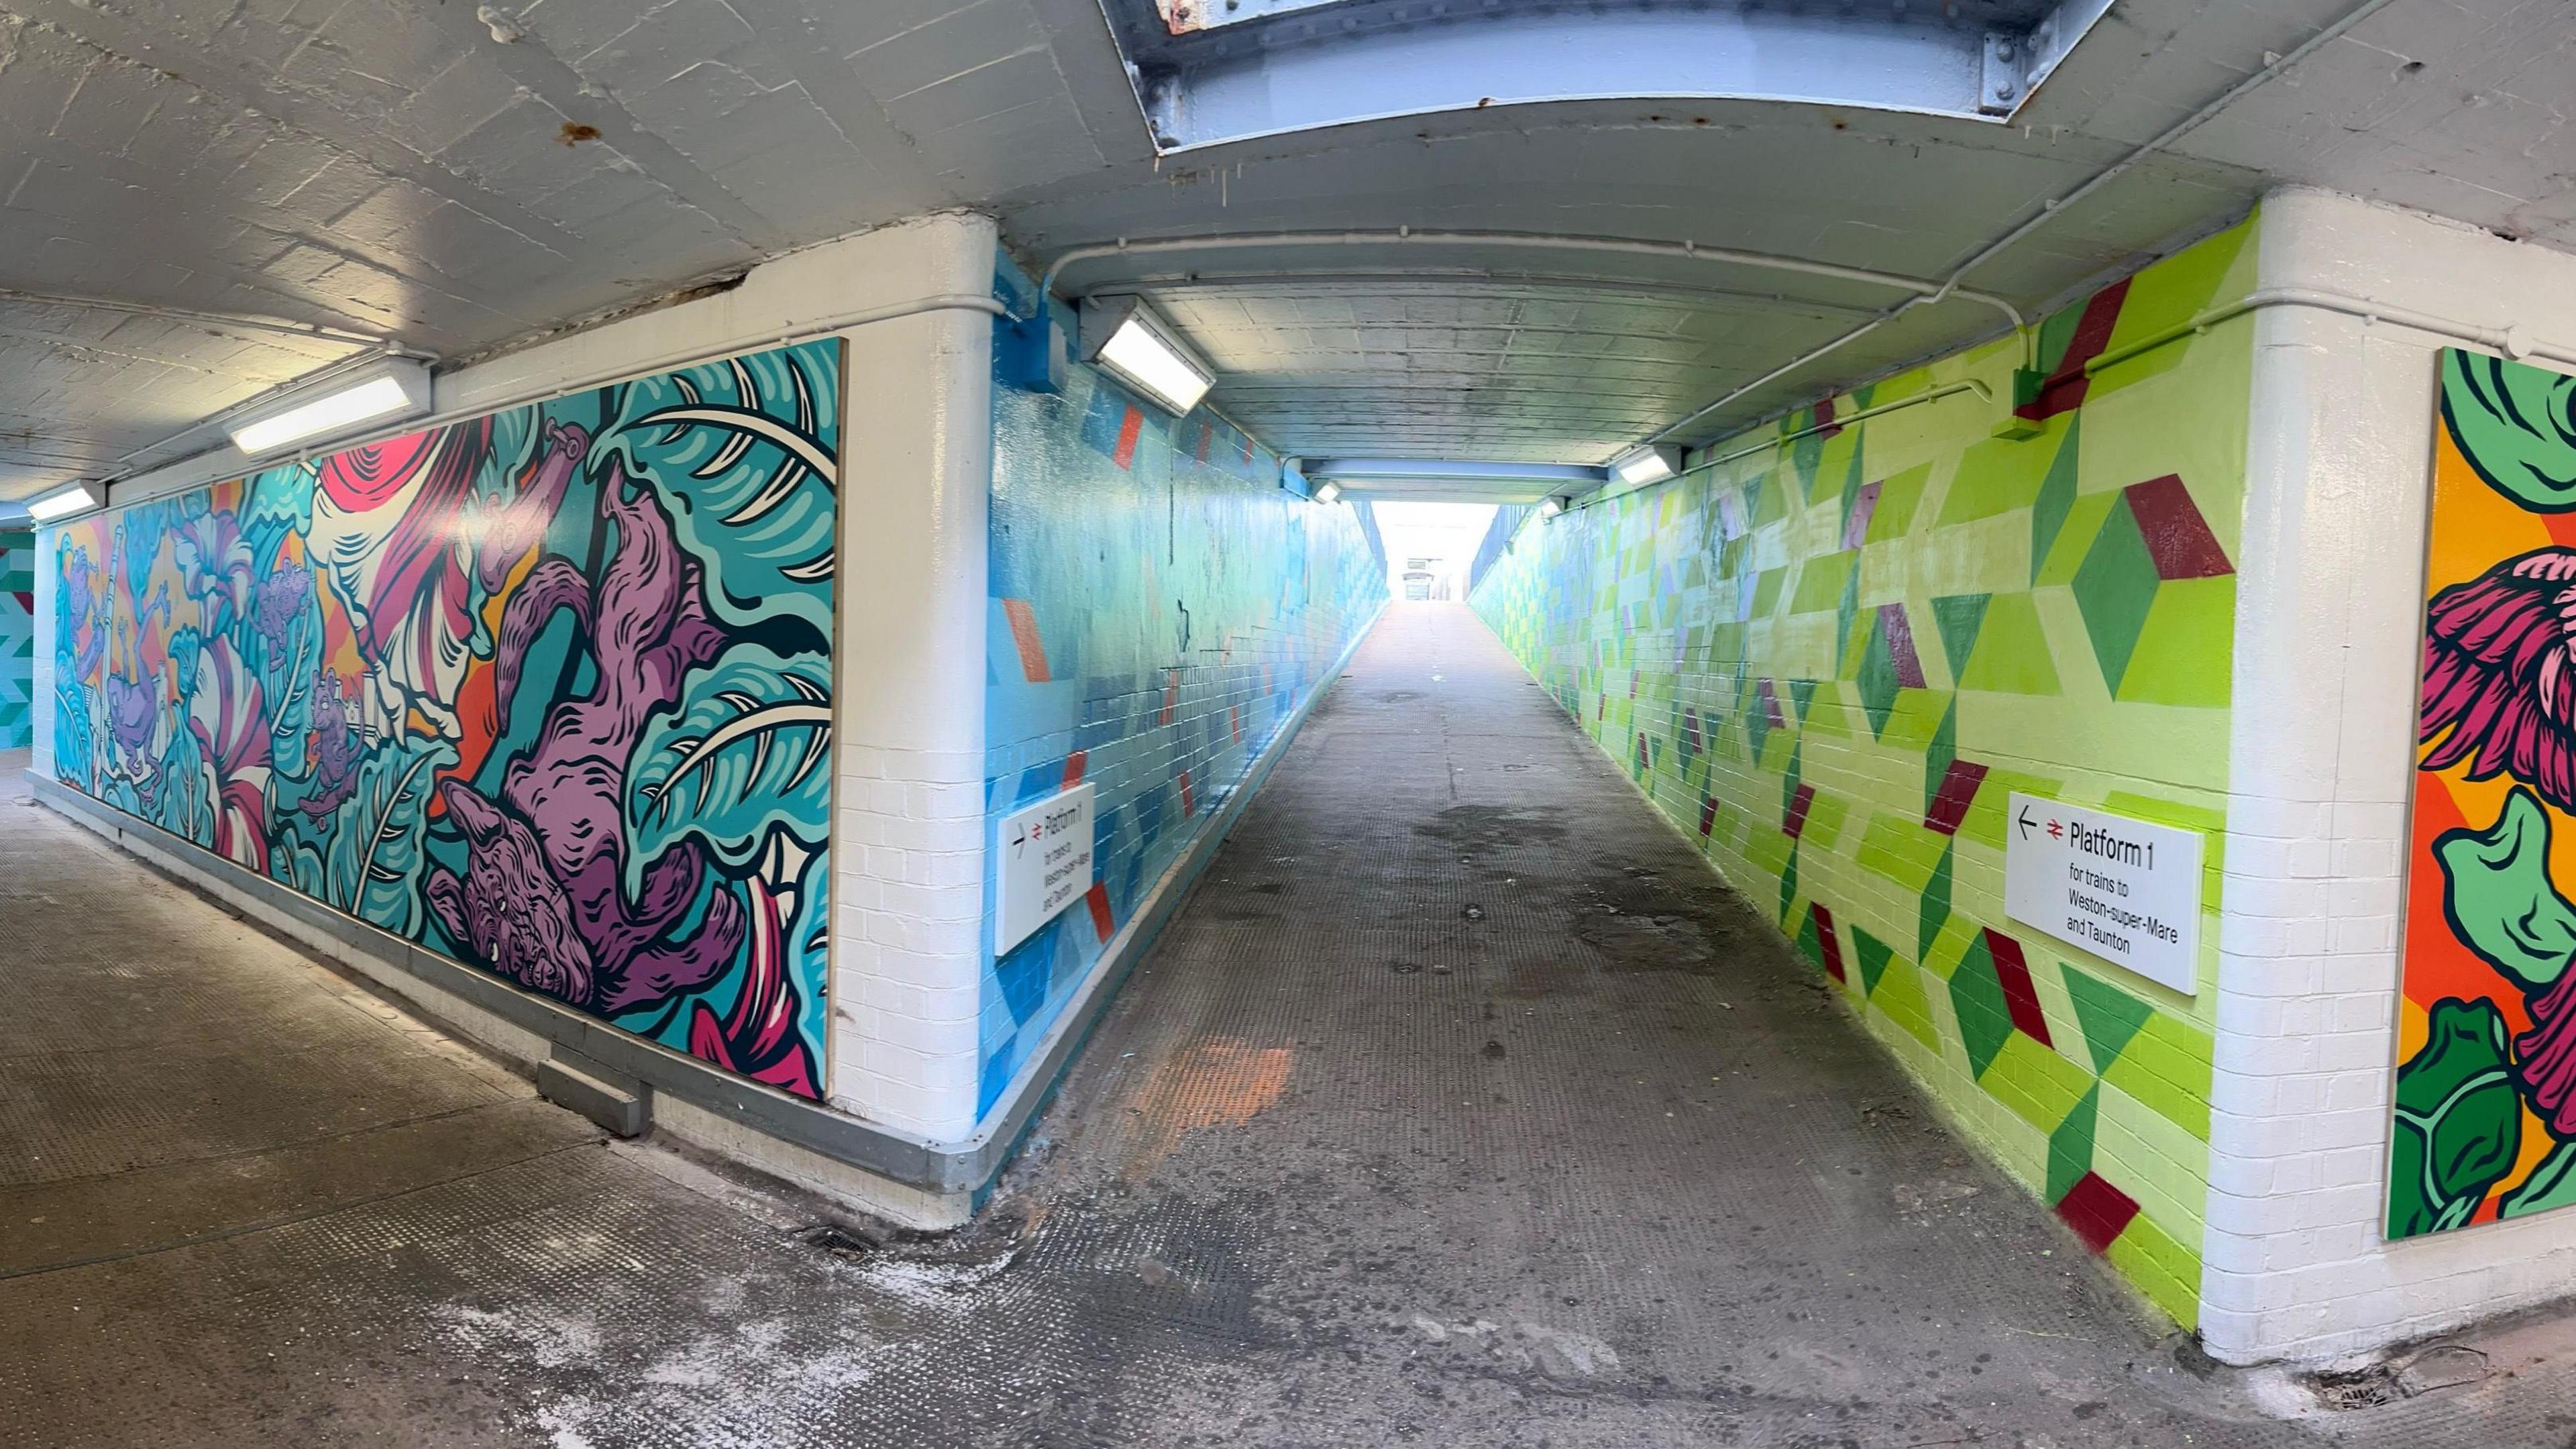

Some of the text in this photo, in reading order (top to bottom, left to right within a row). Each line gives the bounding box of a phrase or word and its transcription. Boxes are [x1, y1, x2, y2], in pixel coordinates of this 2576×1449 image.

[2070, 821, 2153, 871] Platform 1
[2070, 862, 2129, 898] for trains to
[2067, 915, 2130, 955] and Taunton
[2069, 888, 2178, 945] Weston-super-Mare
